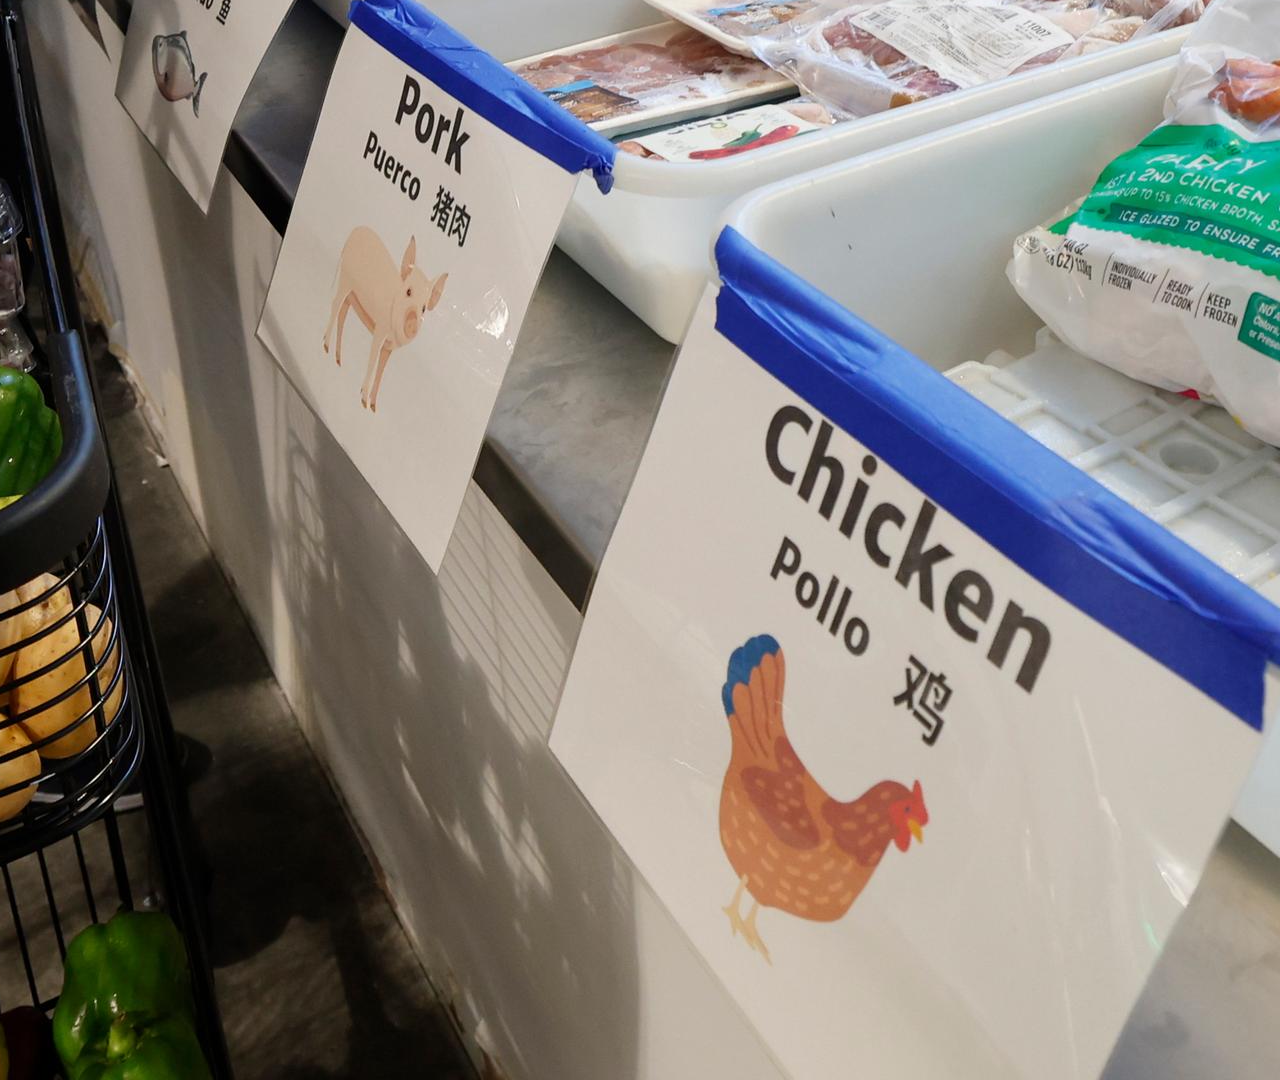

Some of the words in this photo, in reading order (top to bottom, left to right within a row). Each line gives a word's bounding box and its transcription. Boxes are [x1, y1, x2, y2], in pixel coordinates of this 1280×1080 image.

[395, 74, 471, 176] Pork
[363, 130, 421, 202] Puerco
[1137, 167, 1175, 185] 2ND
[1179, 171, 1271, 205] CHICKEN
[1139, 187, 1154, 201] TO
[1173, 193, 1219, 212] CHICKEN
[430, 184, 472, 248] 猪肉
[1118, 209, 1137, 224] ICE
[1139, 212, 1181, 228] GLAZED
[1182, 218, 1202, 233] TO
[1202, 223, 1261, 251] ENSURE
[1108, 273, 1133, 291] FROZEN
[1111, 260, 1158, 285] INDIVIDUALLY
[1166, 279, 1194, 297] READY
[1160, 291, 1173, 304] TO
[1170, 296, 1194, 313] COOK
[1206, 291, 1232, 310] KEEP
[1202, 306, 1239, 328] FROZEN
[1248, 329, 1258, 340] or
[764, 405, 1052, 695] Chicken
[769, 535, 870, 657] Pollo
[892, 653, 954, 748] 鸡
